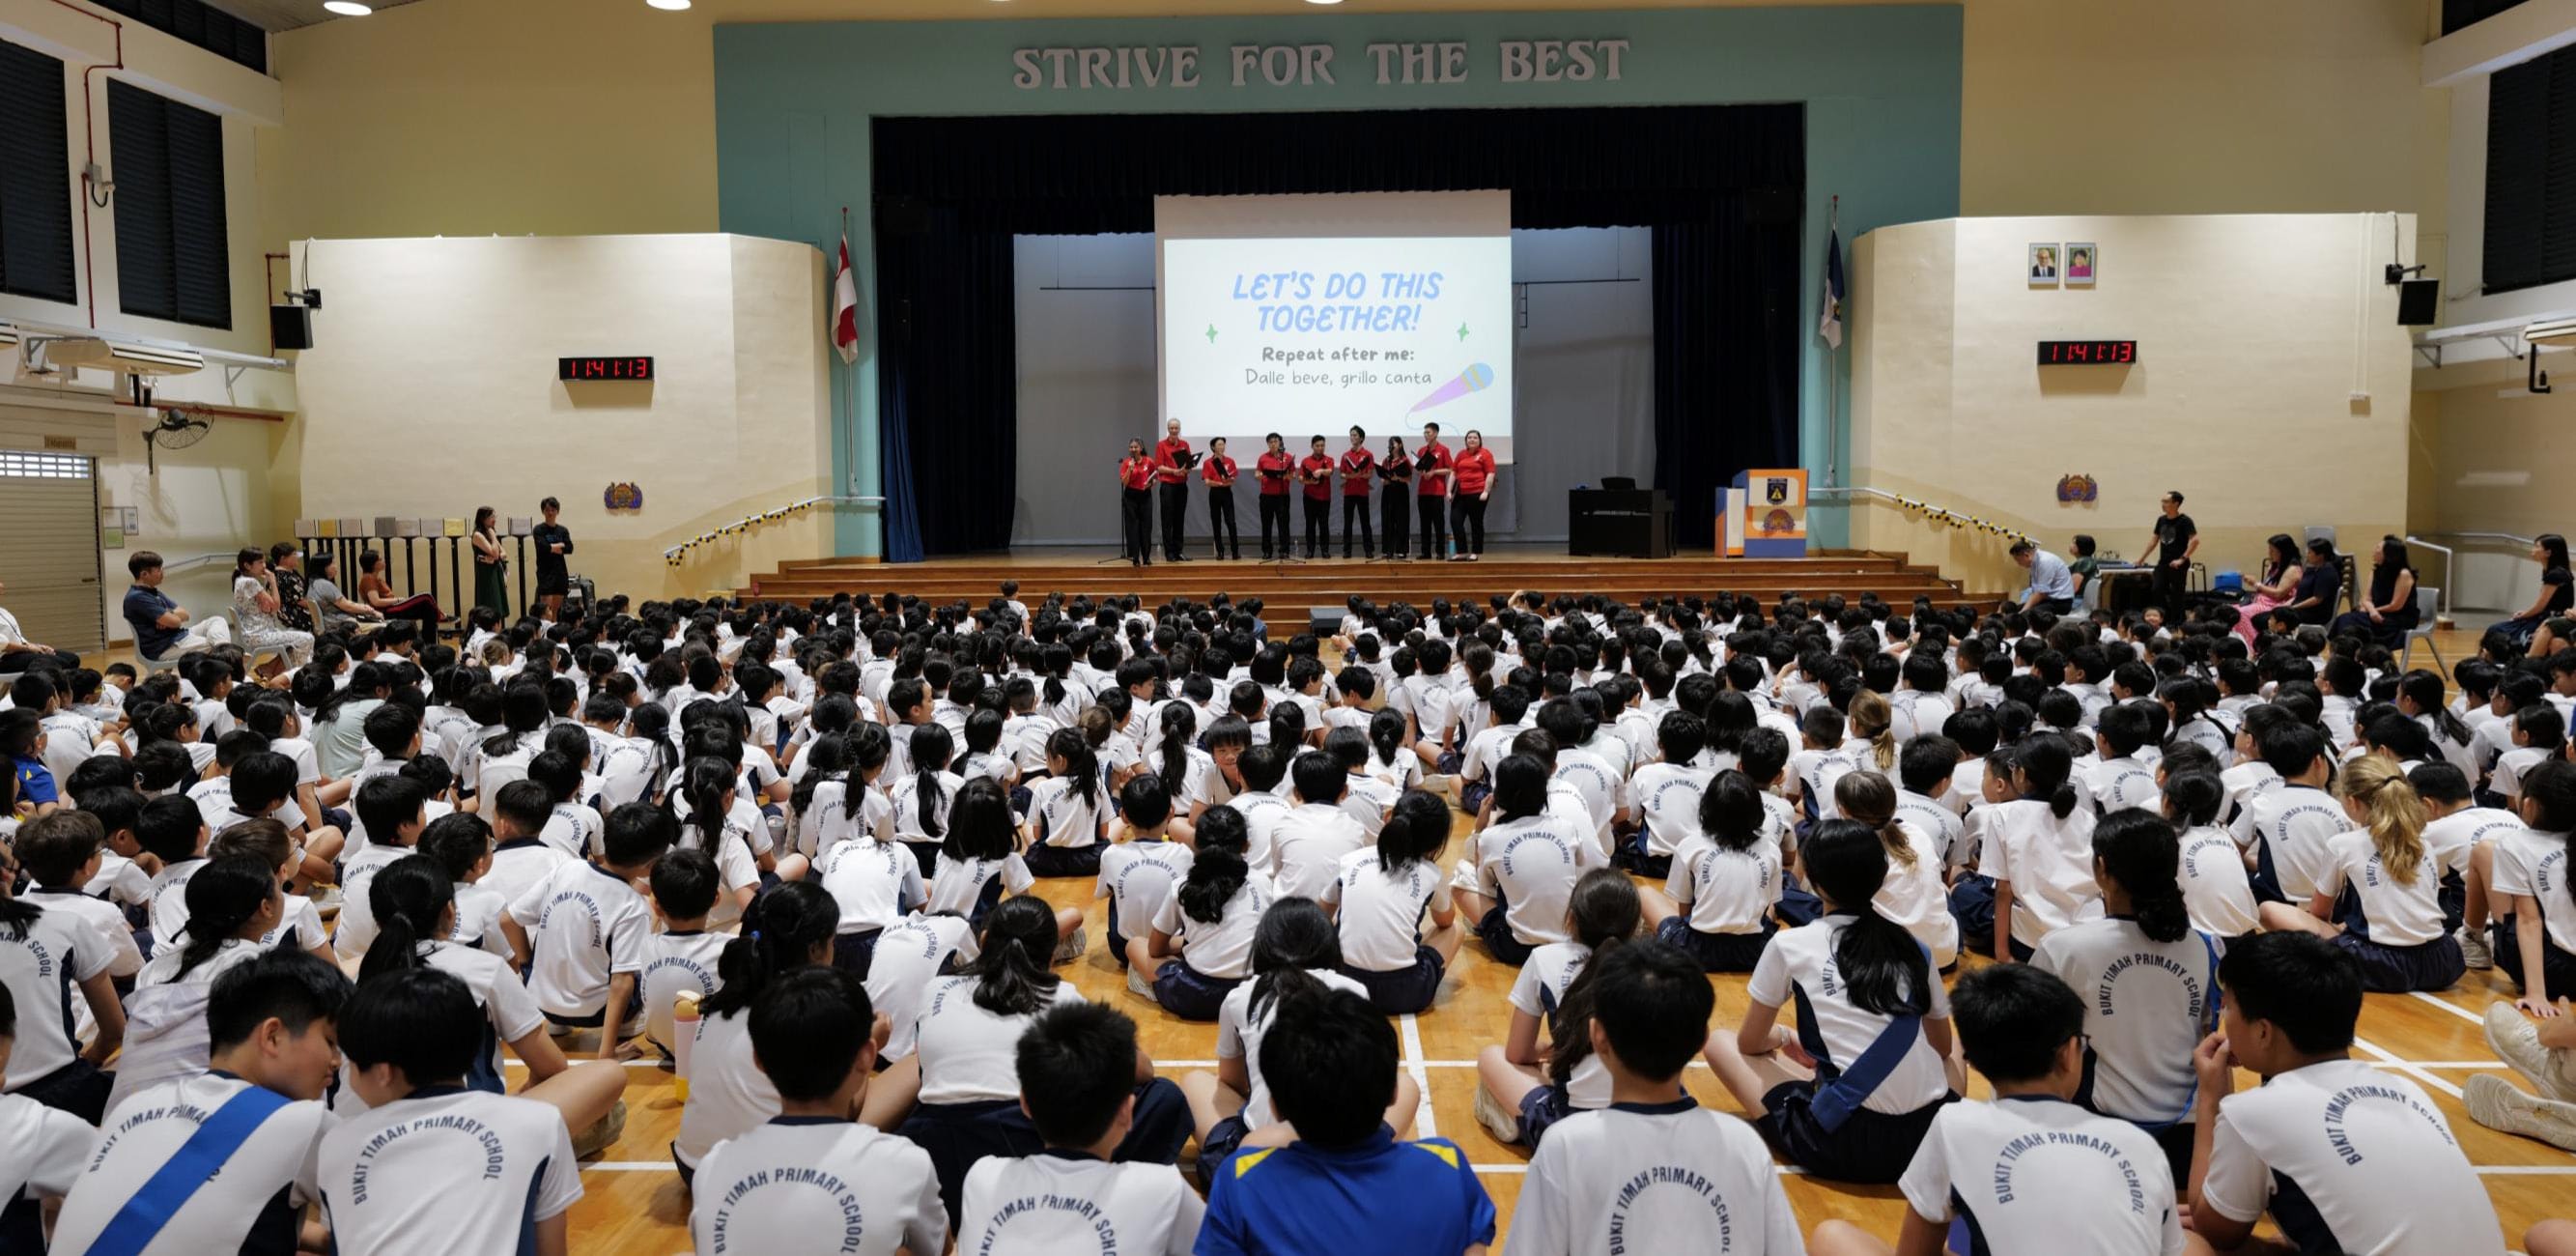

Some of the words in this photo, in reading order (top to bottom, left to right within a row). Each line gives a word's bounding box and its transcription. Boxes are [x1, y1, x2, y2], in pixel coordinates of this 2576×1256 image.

[1013, 46, 1201, 89] STRIVE
[1231, 44, 1335, 86] FOR
[1367, 43, 1469, 84] THE
[1499, 40, 1629, 82] BEST
[1232, 271, 1315, 300] LET'S
[1324, 271, 1367, 300] DO
[1381, 271, 1444, 300] THIS
[1258, 303, 1422, 332] TOGETHER!
[1261, 347, 1325, 366] Repeat
[1331, 347, 1378, 361] after
[1384, 349, 1415, 361] me:
[1245, 368, 1285, 385] Dalle
[1292, 371, 1333, 387] beve,
[1341, 371, 1377, 388] grillo
[1385, 372, 1431, 385] canta
[2303, 805, 2336, 819] PRIMARY
[1506, 834, 1524, 854] TIMAH
[1522, 831, 1556, 842] PRIMARY
[2366, 868, 2379, 888] BUKIT
[27, 940, 52, 978] SCHOOL
[665, 956, 700, 974] PRIMARY
[2103, 956, 2134, 983] TIMAH
[2135, 954, 2187, 978] PRIMARY
[1822, 967, 1837, 997] BUKIT
[2183, 976, 2200, 1017] SCHOOL
[2099, 984, 2113, 1016] BUKIT
[2325, 1091, 2354, 1124] TIMAH
[2346, 1085, 2408, 1104] PRIMARY
[119, 1107, 164, 1134] TIMAH
[2000, 1132, 2046, 1161] TIMAH
[2047, 1131, 2121, 1159] PRIMARY
[2325, 1127, 2364, 1166] BUKIT
[353, 1163, 369, 1206] BUKIT
[362, 1125, 408, 1158] TIMAH
[412, 1115, 484, 1134] PRIMARY
[478, 1130, 503, 1181] SCHOOL
[1995, 1162, 2014, 1205] BUKIT
[2117, 1159, 2144, 1215] SCHOOL
[714, 1210, 729, 1255] BUKIT
[724, 1170, 768, 1207] TIMAH
[775, 1167, 847, 1195] PRIMARY
[839, 1193, 863, 1254] SCHOOL
[993, 1196, 1035, 1227] TIMAH
[1040, 1194, 1102, 1222] PRIMARY
[1609, 1213, 1625, 1256] BUKIT
[1617, 1170, 1651, 1210] TIMAH
[1652, 1166, 1713, 1197] PRIMARY
[1711, 1193, 1731, 1254] SCHOOL
